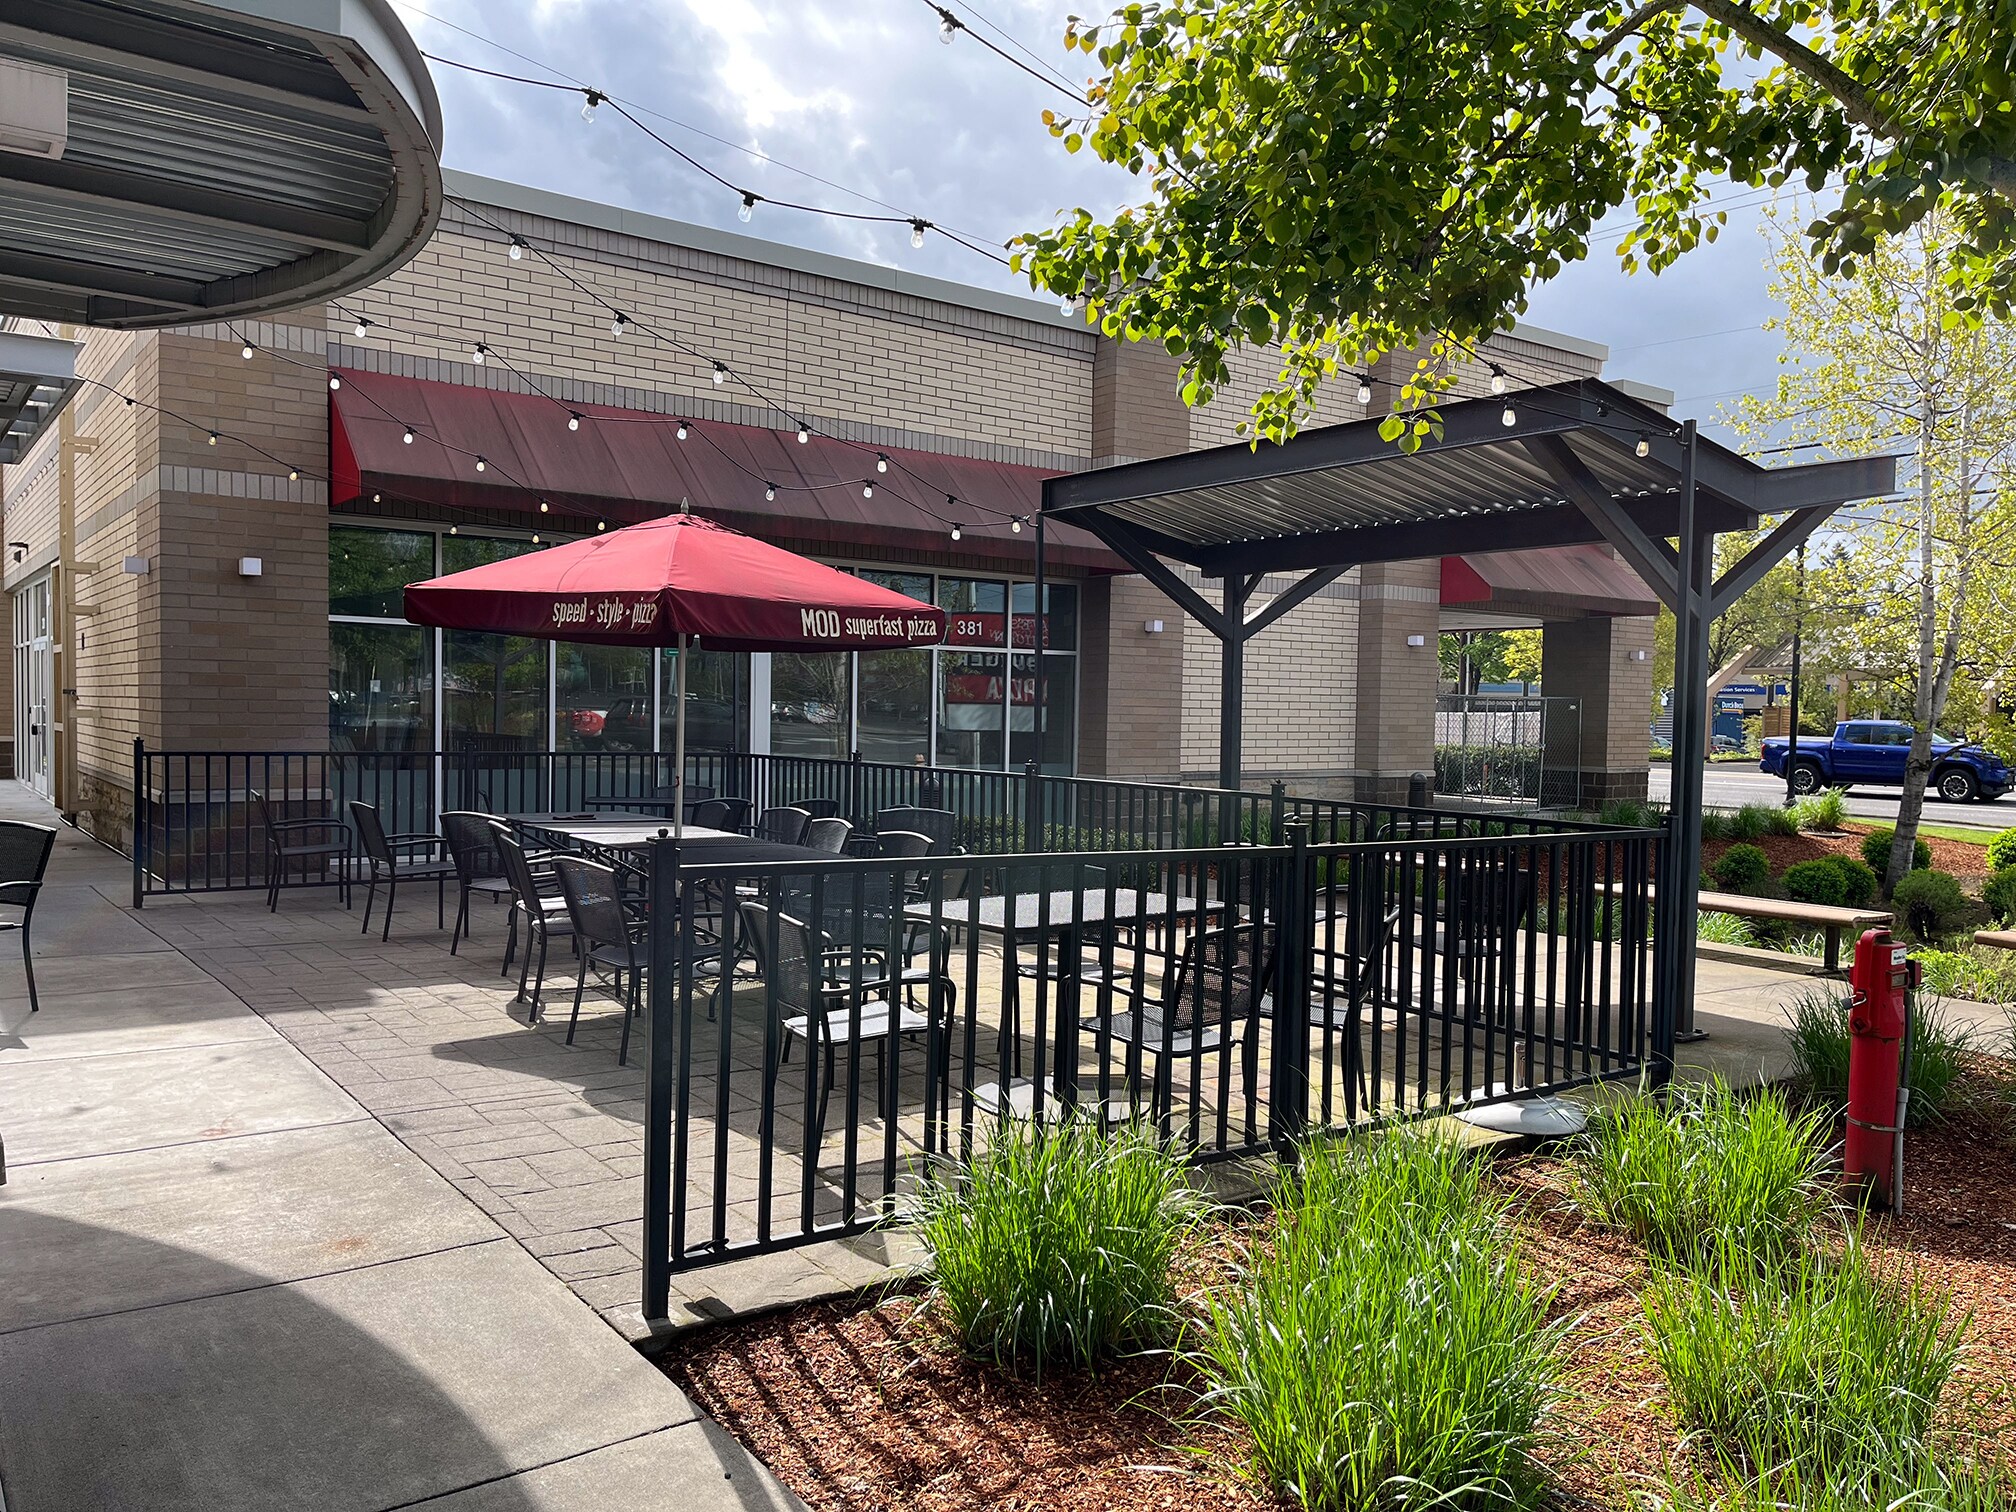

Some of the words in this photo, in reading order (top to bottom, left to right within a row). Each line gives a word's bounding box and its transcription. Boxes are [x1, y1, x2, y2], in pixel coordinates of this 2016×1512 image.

[552, 597, 588, 628] speed
[596, 596, 624, 629] style
[631, 596, 658, 629] pizza
[800, 608, 841, 638] MOD
[845, 614, 904, 640] superfast
[907, 615, 937, 641] pizza
[957, 620, 983, 636] 381
